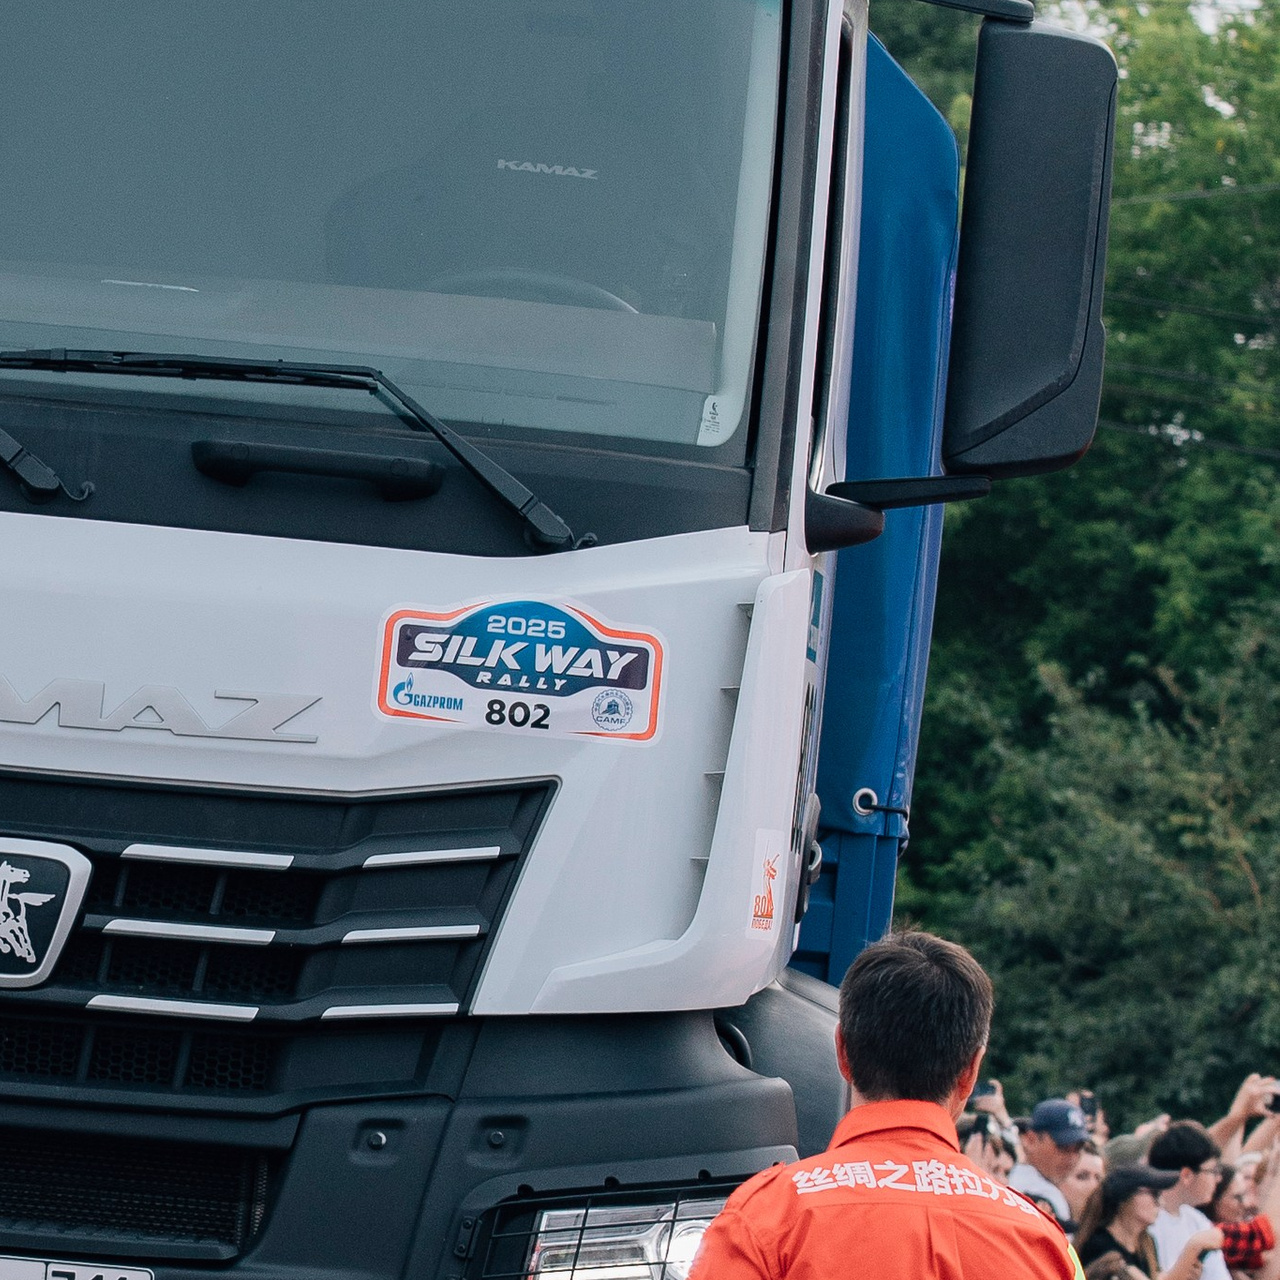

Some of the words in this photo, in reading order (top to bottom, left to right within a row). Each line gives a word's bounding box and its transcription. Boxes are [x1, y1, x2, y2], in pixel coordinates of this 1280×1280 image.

[497, 159, 598, 179] KAMAZ
[486, 614, 566, 640] 2025
[408, 631, 529, 670] SILK
[533, 644, 639, 680] WAY
[475, 671, 568, 691] RALLY
[413, 693, 464, 711] GAZPROM
[484, 698, 551, 730] 802
[596, 716, 626, 725] CAMF
